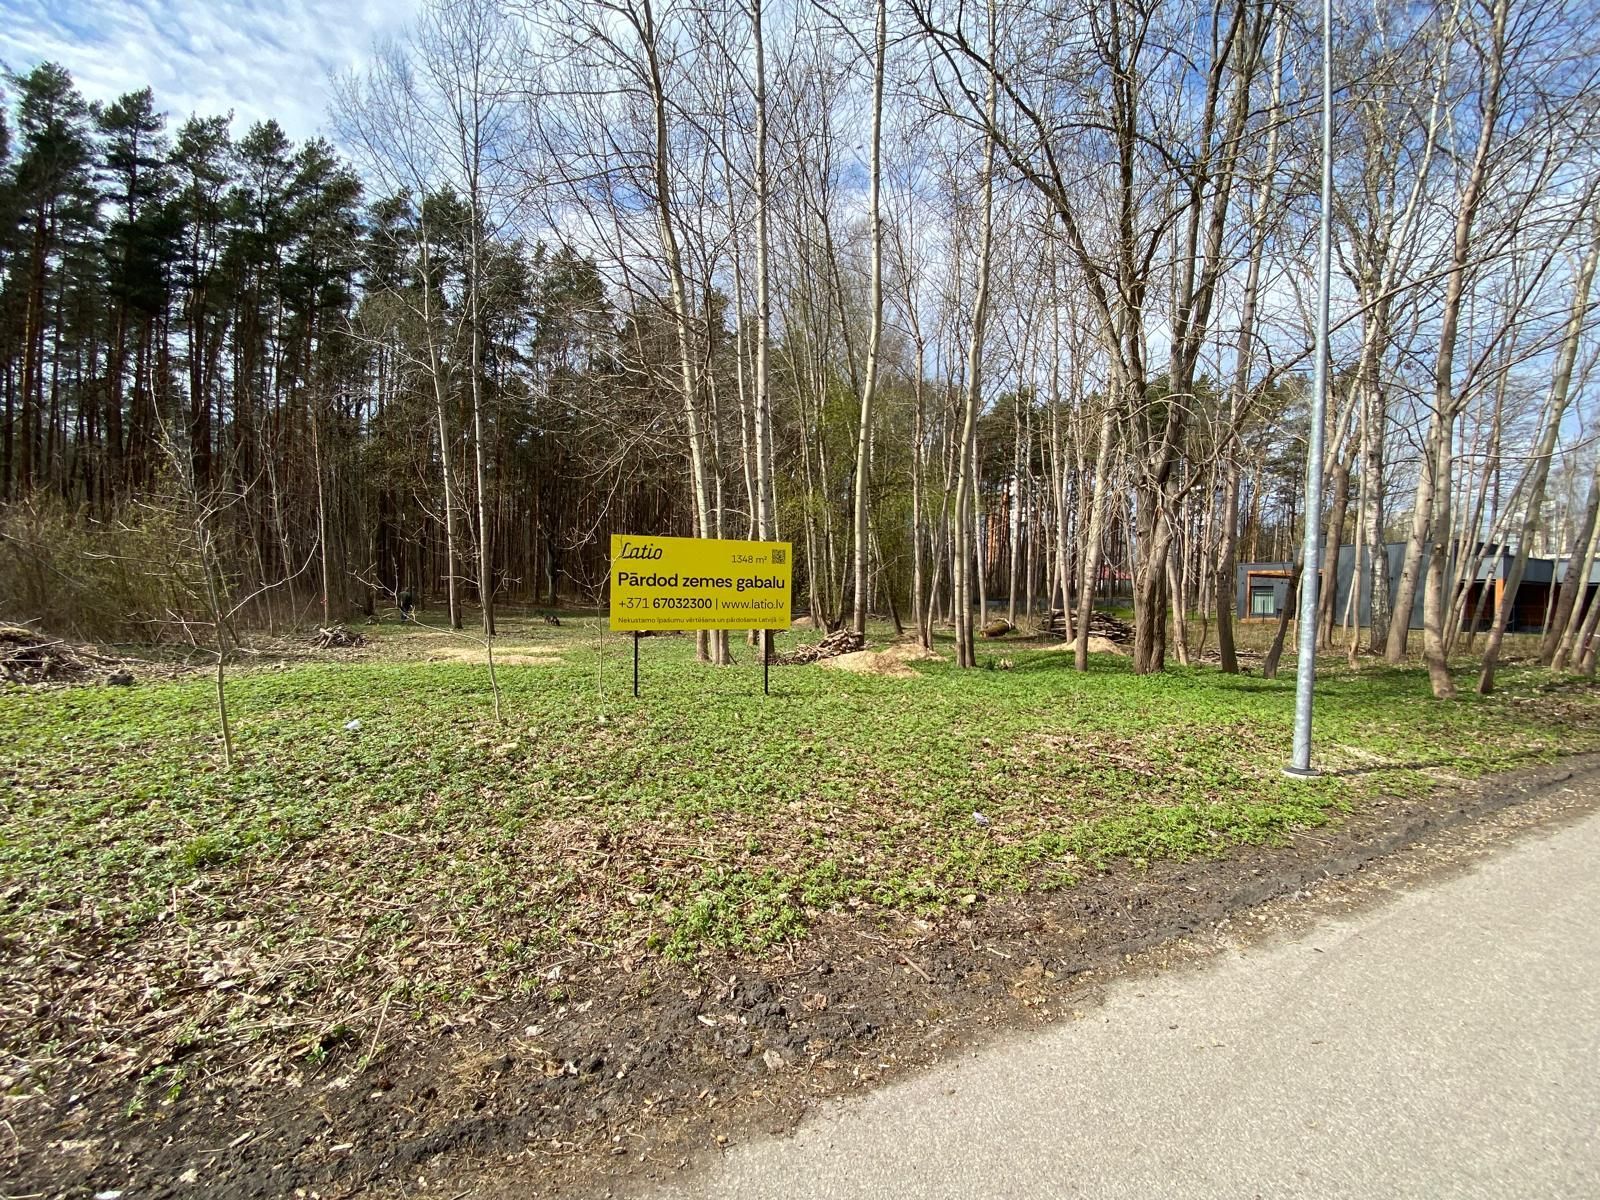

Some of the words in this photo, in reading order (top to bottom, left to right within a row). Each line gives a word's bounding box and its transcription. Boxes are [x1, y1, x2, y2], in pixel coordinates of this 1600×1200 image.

[621, 542, 663, 560] Latio
[731, 554, 753, 564] 1348
[618, 572, 678, 587] Pārdod
[682, 577, 733, 589] zemes
[736, 576, 785, 592] gabalu
[618, 597, 649, 609] +371
[653, 597, 712, 609] 67032300
[721, 598, 784, 609] www.latio.lv
